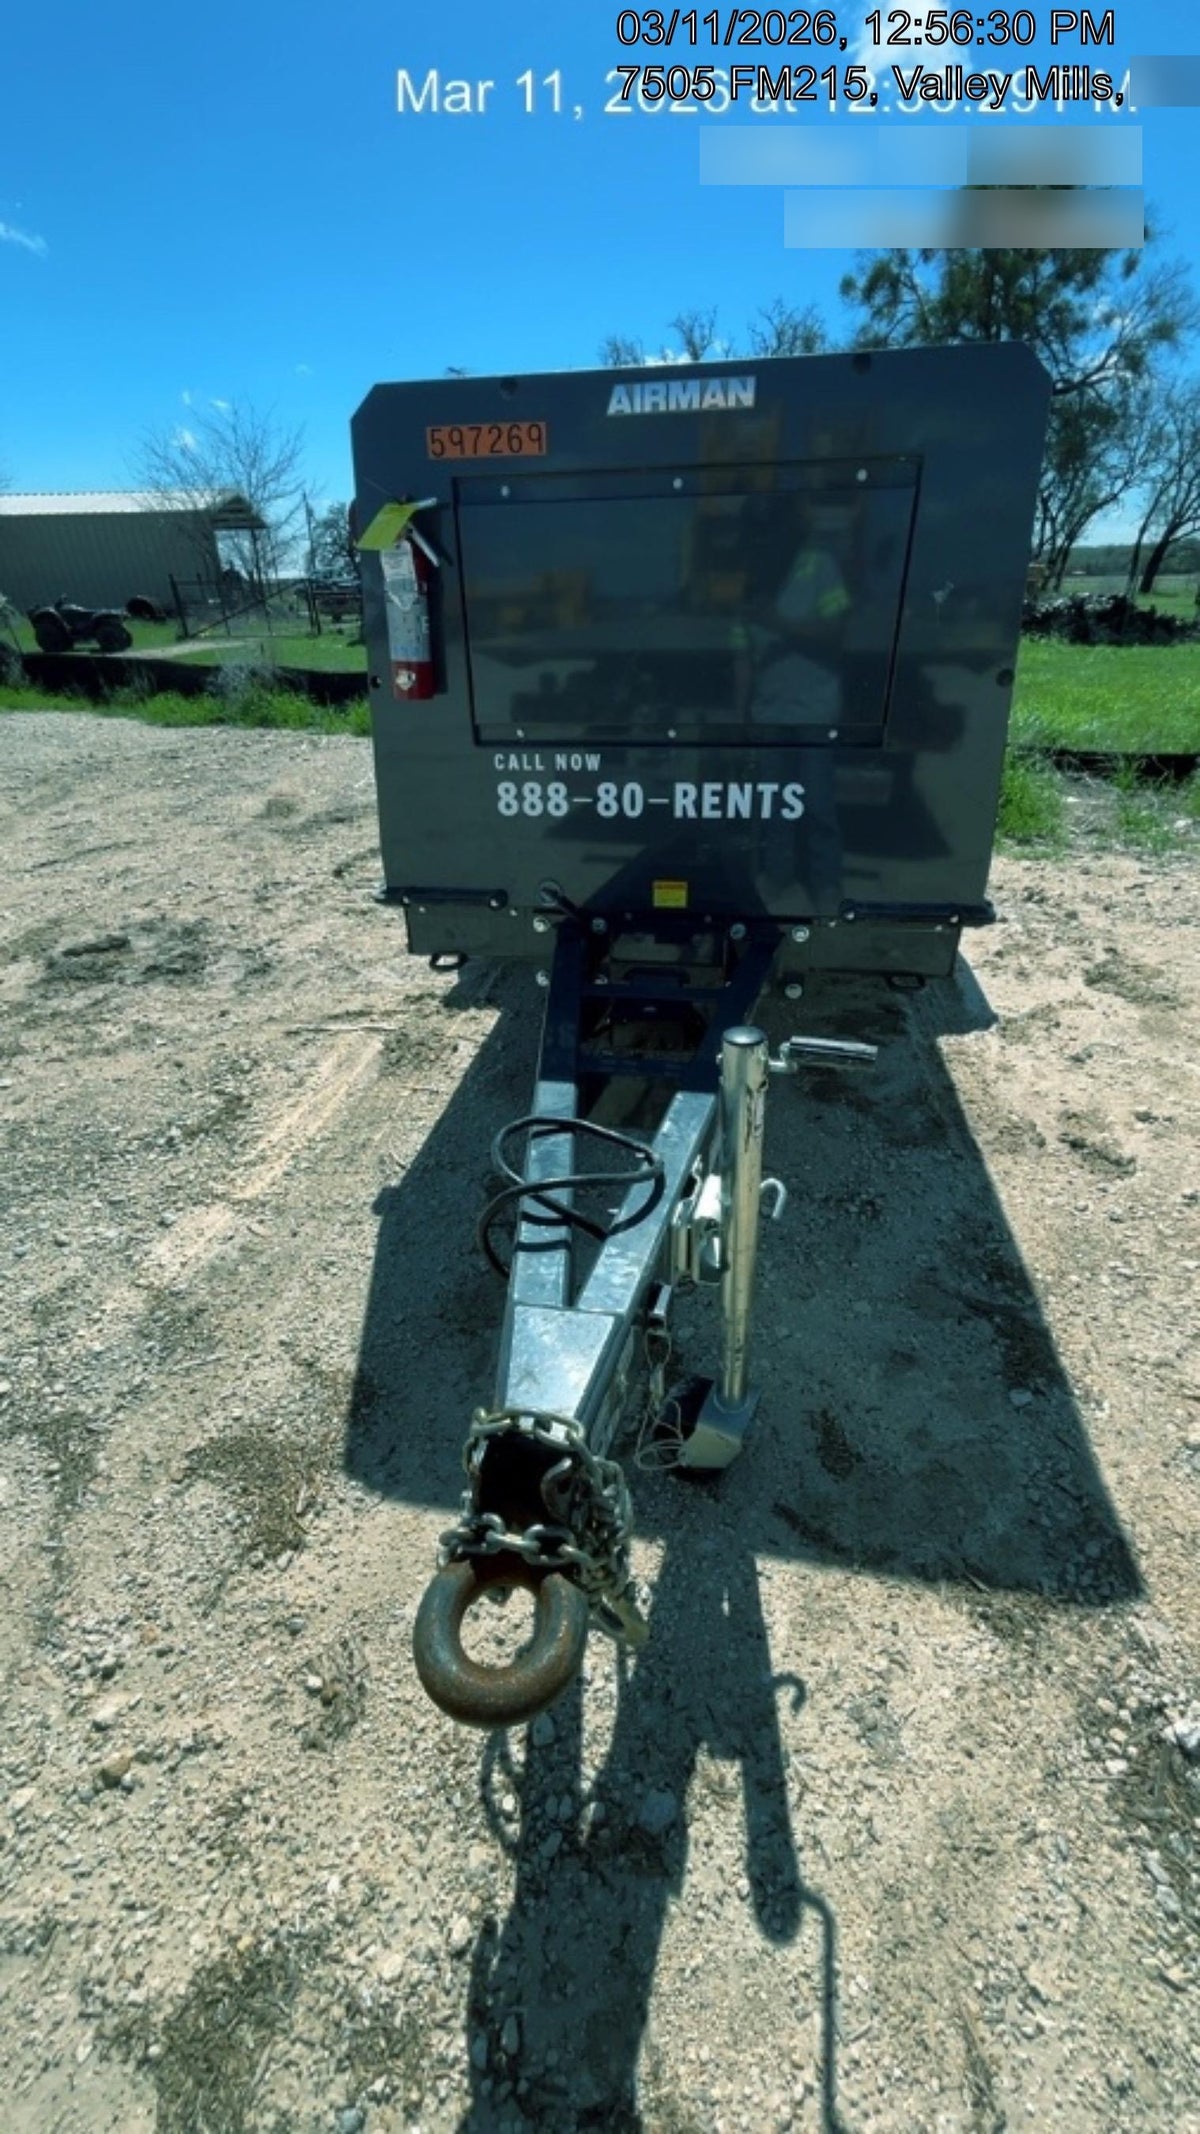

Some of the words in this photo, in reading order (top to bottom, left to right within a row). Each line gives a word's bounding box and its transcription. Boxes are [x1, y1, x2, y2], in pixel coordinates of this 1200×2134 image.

[606, 375, 757, 416] AIRMAN
[430, 423, 543, 458] 597269
[493, 753, 546, 772] CALL
[554, 753, 602, 772] NOW
[496, 781, 806, 820] 888-80-RENTS
